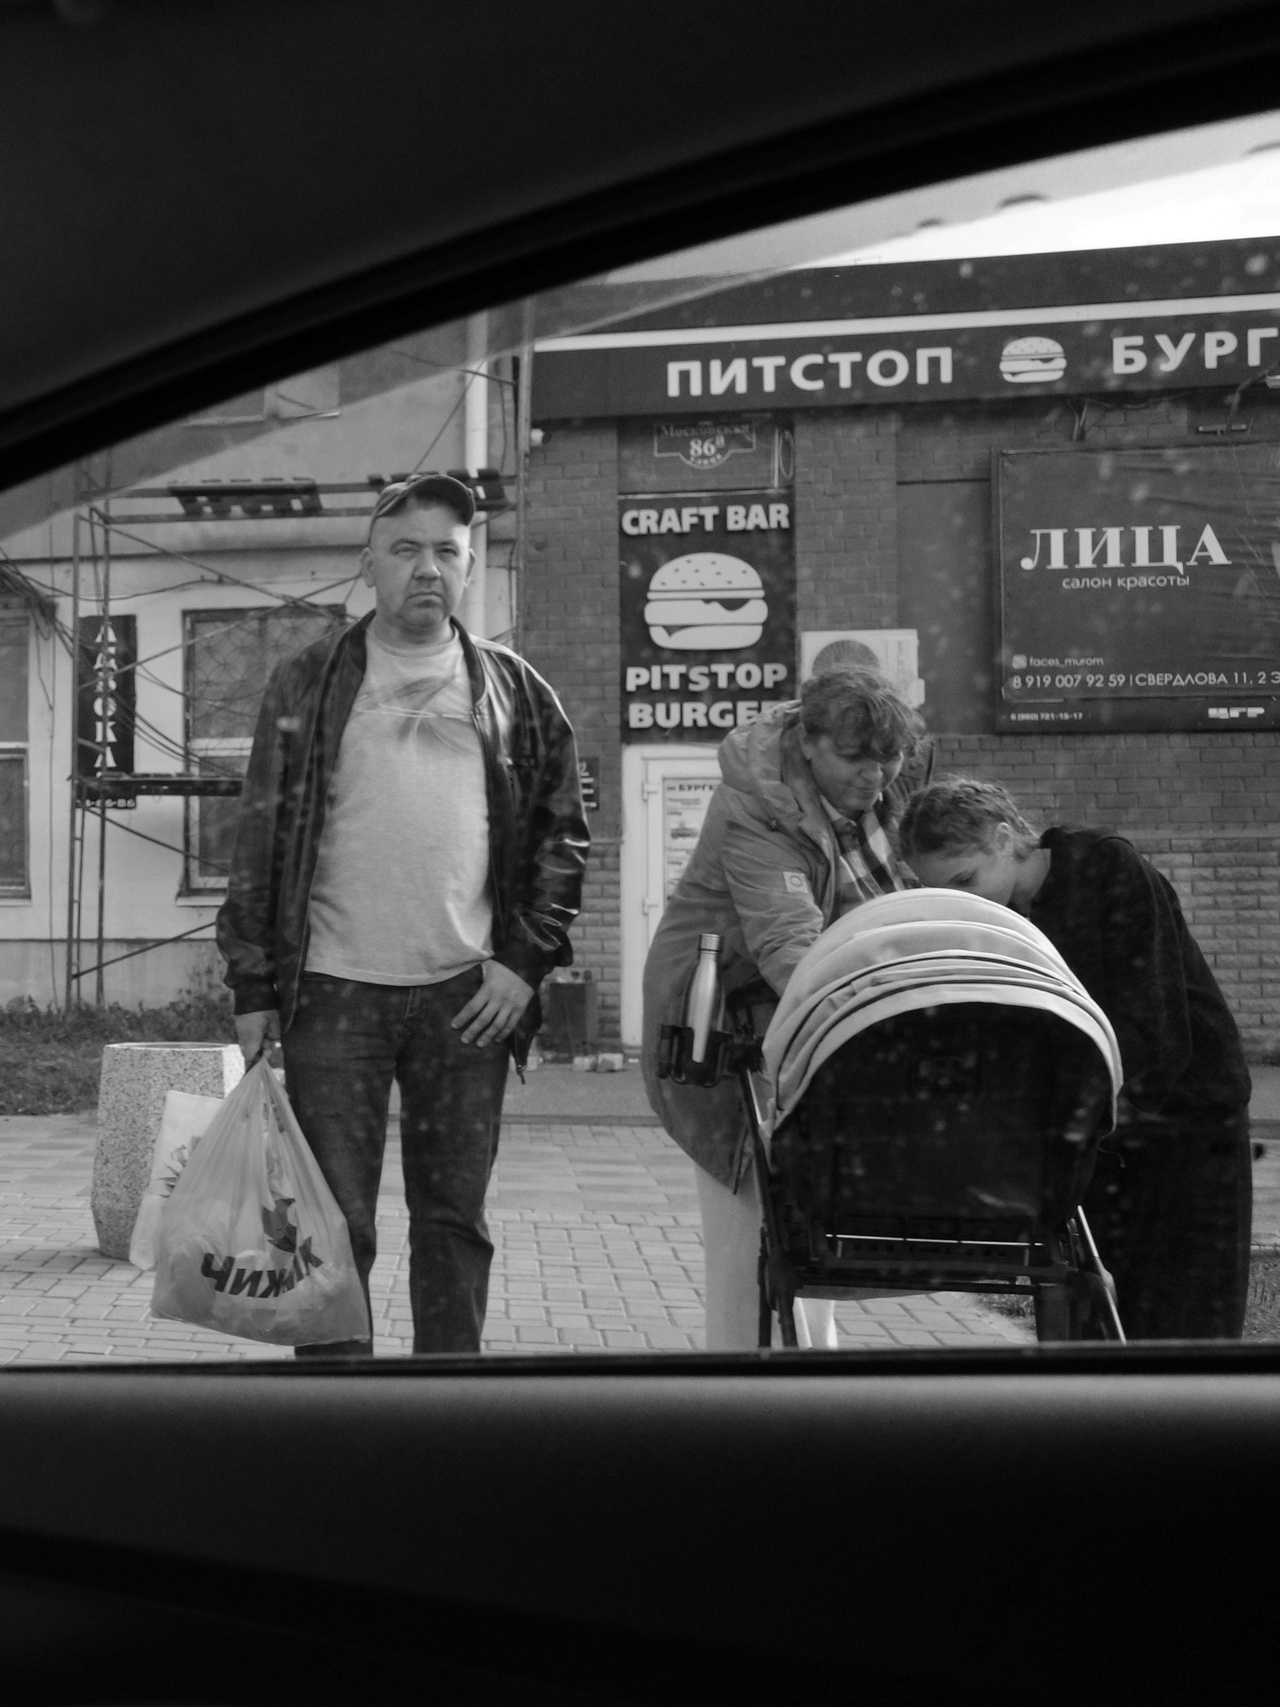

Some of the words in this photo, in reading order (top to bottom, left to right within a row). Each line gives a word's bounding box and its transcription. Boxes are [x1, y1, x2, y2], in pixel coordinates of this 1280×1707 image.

[666, 346, 953, 398] ПИТСТОП
[1112, 327, 1279, 375] БУРГ
[621, 506, 720, 536] CRAFT
[726, 503, 790, 531] BAR
[1020, 523, 1233, 576] ЛИЦА
[1062, 576, 1112, 590] салон
[1117, 575, 1190, 591] красоты
[626, 662, 788, 692] PITSTOP
[1012, 675, 1022, 689] 8
[1025, 674, 1052, 688] 919
[1055, 673, 1082, 688] 007
[1086, 673, 1104, 688] 92
[1108, 672, 1126, 688] 59
[1135, 671, 1228, 687] СВЕРДЛОВА
[1257, 670, 1267, 685] 2
